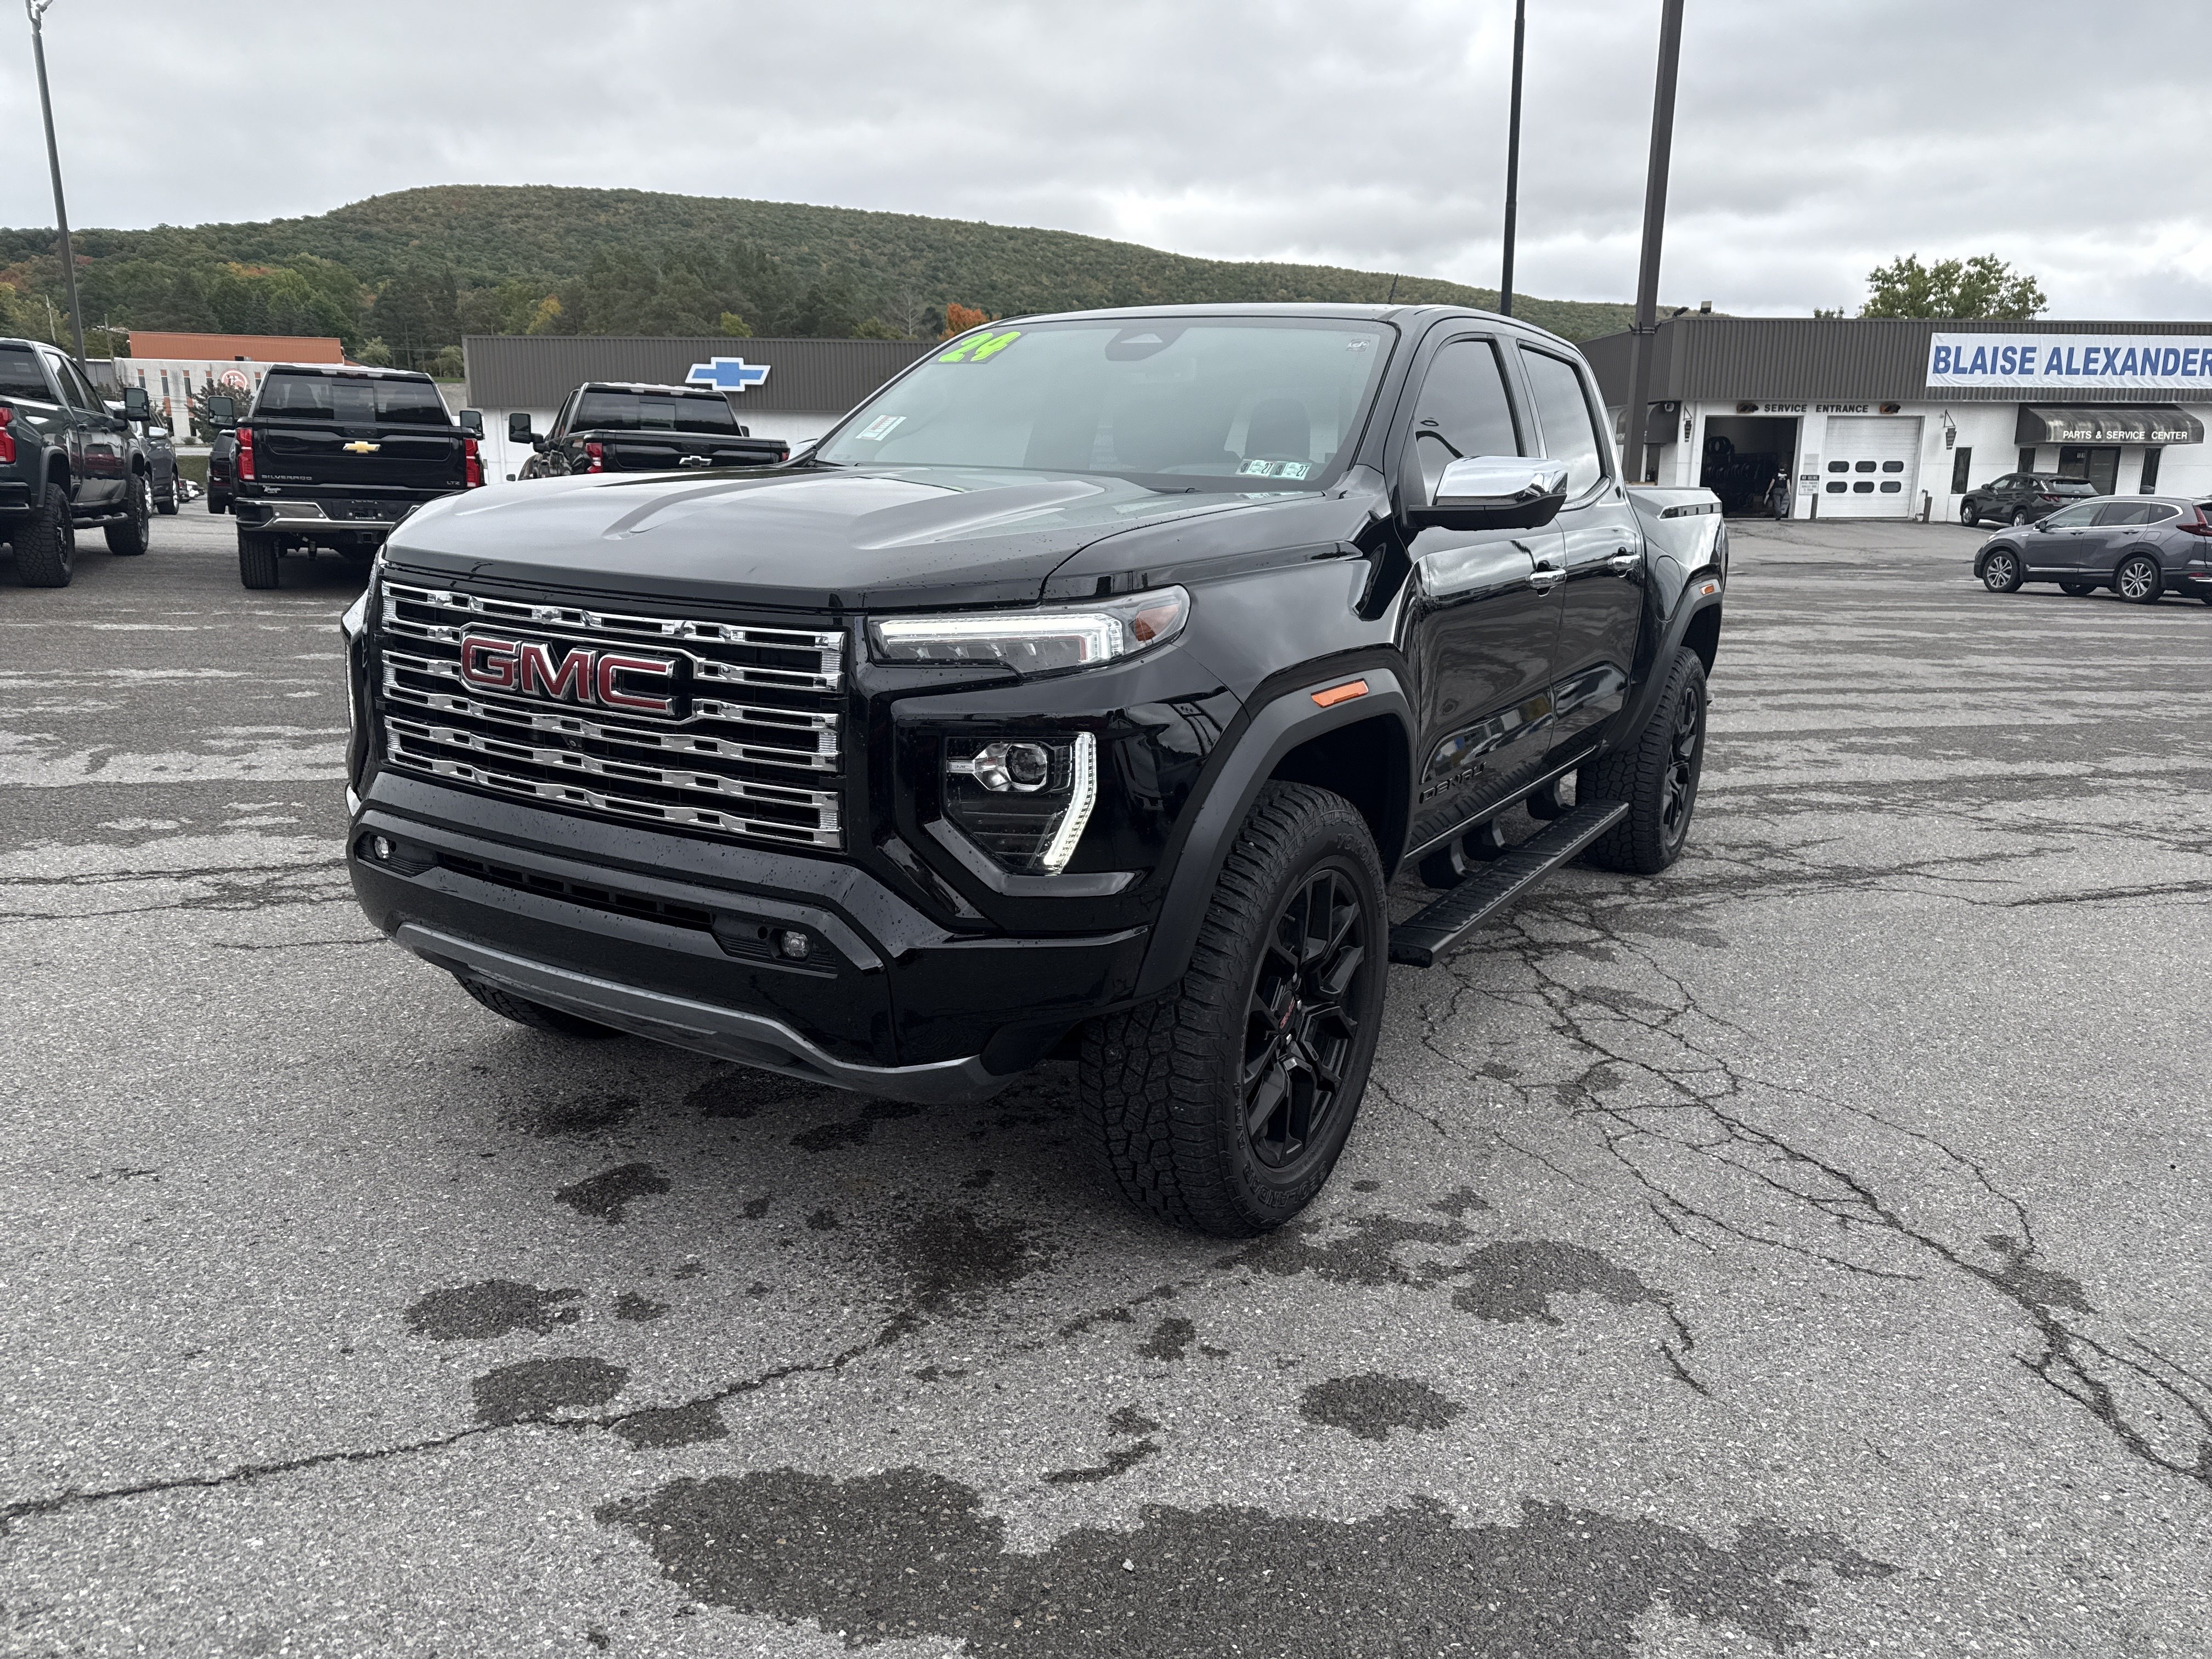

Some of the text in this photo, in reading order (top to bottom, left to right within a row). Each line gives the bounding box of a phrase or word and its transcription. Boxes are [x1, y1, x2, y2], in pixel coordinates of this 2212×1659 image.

[939, 331, 1021, 362] 24
[1933, 346, 2212, 376] BLAISE ALEXANDER
[1764, 404, 1869, 413] SERVICE ENTRANCE
[2063, 430, 2188, 440] PARTS & SERVICE CENTER
[1240, 462, 1273, 475] 3 27
[1275, 465, 1308, 478] 3 27
[461, 634, 678, 715] GMC
[1243, 1159, 1328, 1208] GEOLANDAR
